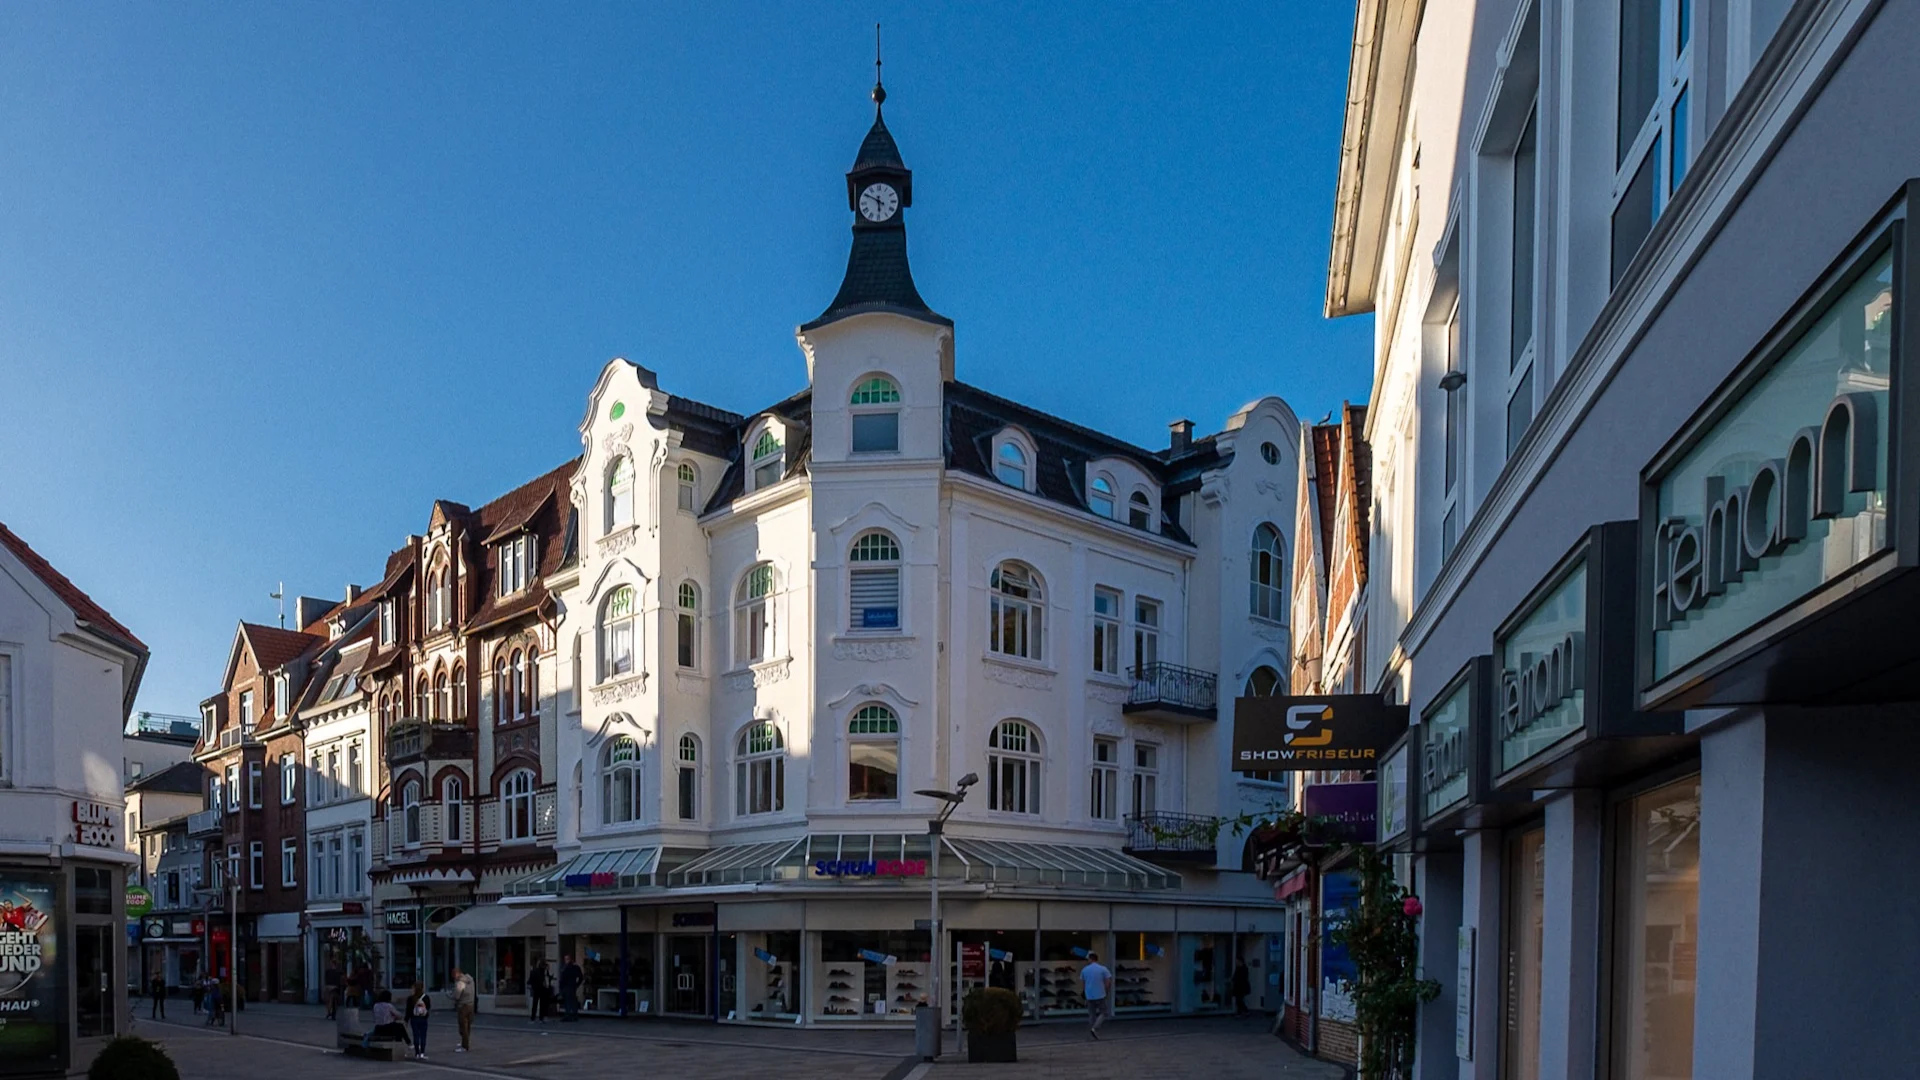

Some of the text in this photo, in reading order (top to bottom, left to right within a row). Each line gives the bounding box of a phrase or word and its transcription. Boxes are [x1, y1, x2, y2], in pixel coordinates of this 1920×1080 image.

[1653, 391, 1878, 631] fielmann
[1499, 632, 1584, 741] fielmann
[1240, 748, 1376, 760] SHOWFRISEUR
[386, 911, 410, 925] HAGEL
